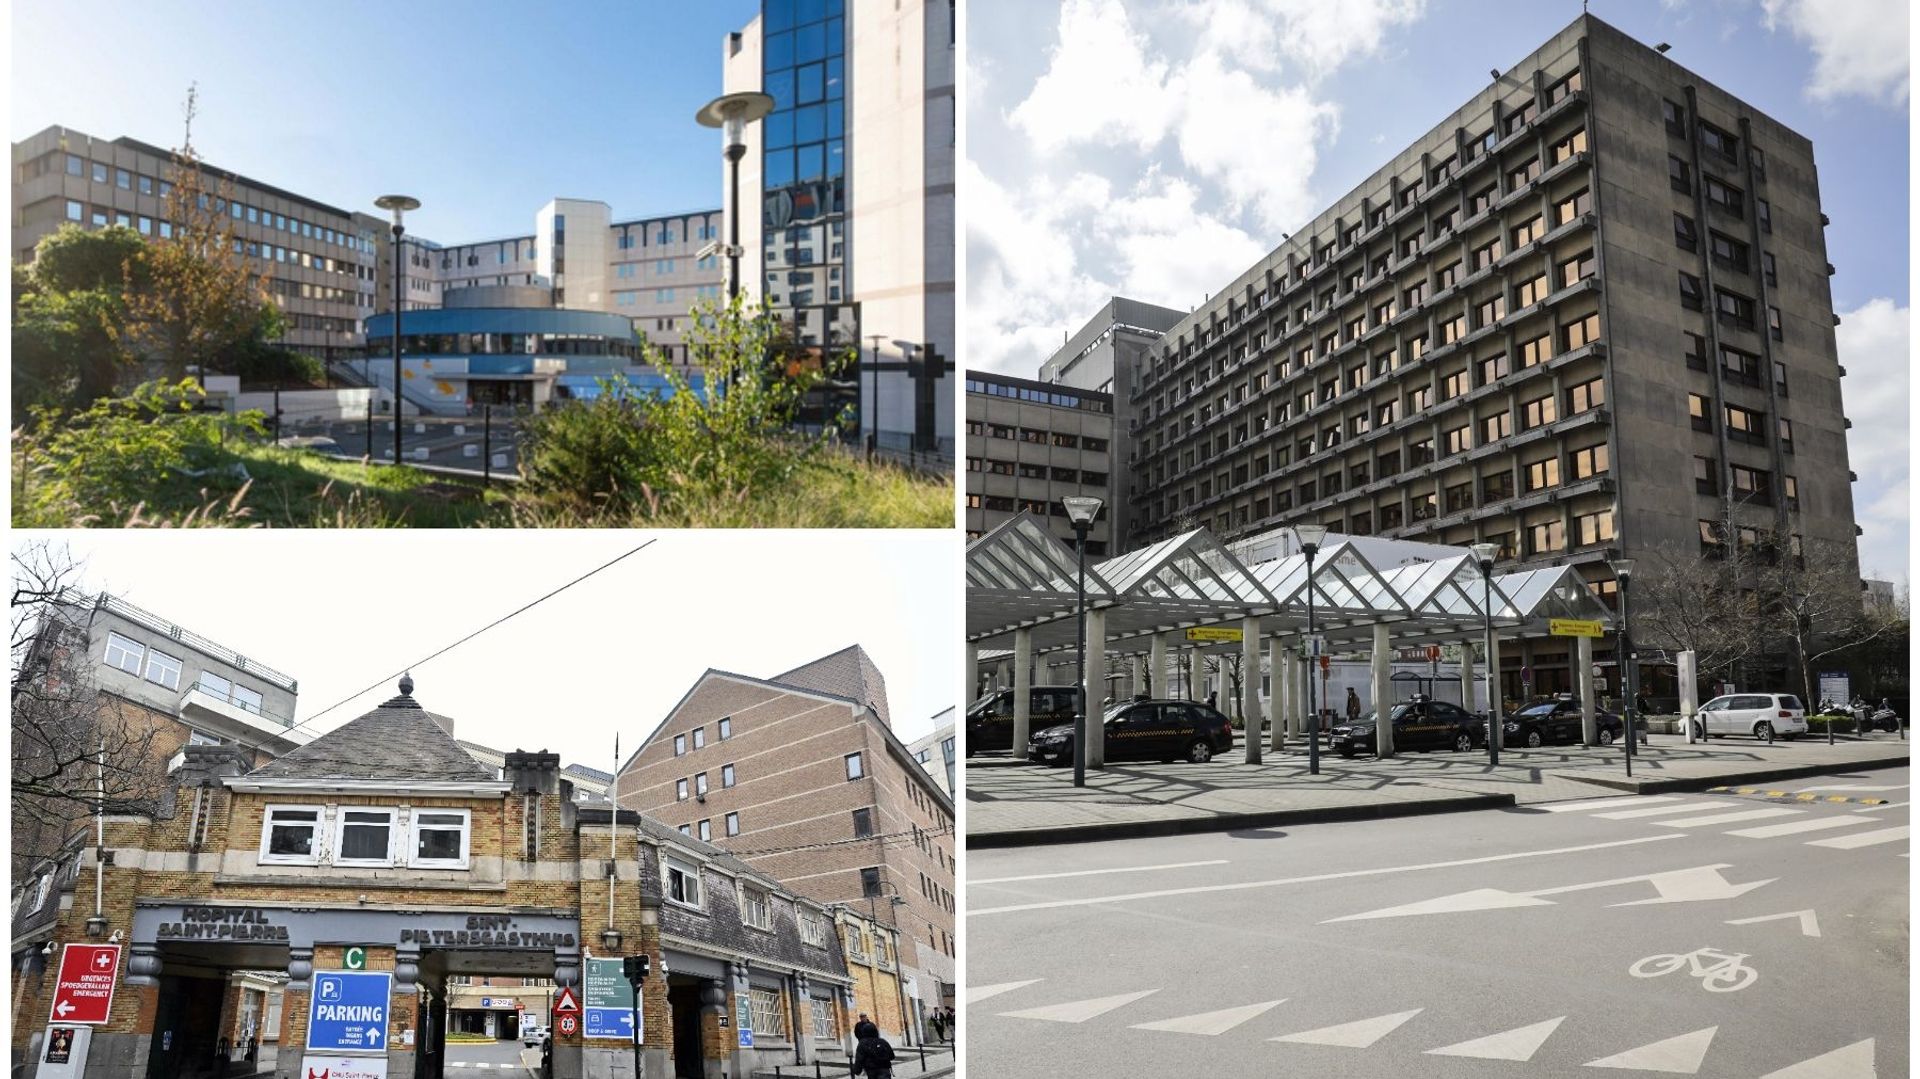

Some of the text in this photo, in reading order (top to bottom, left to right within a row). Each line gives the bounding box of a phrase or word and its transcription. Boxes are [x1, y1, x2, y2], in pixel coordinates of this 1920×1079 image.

[157, 922, 290, 939] SAINT-PIERRE
[400, 929, 575, 947] PIETERSGASTHUIS
[346, 947, 363, 969] C
[80, 974, 112, 983] URGENCES
[72, 990, 109, 998] EMERGENCY
[316, 1004, 382, 1022] PARKING
